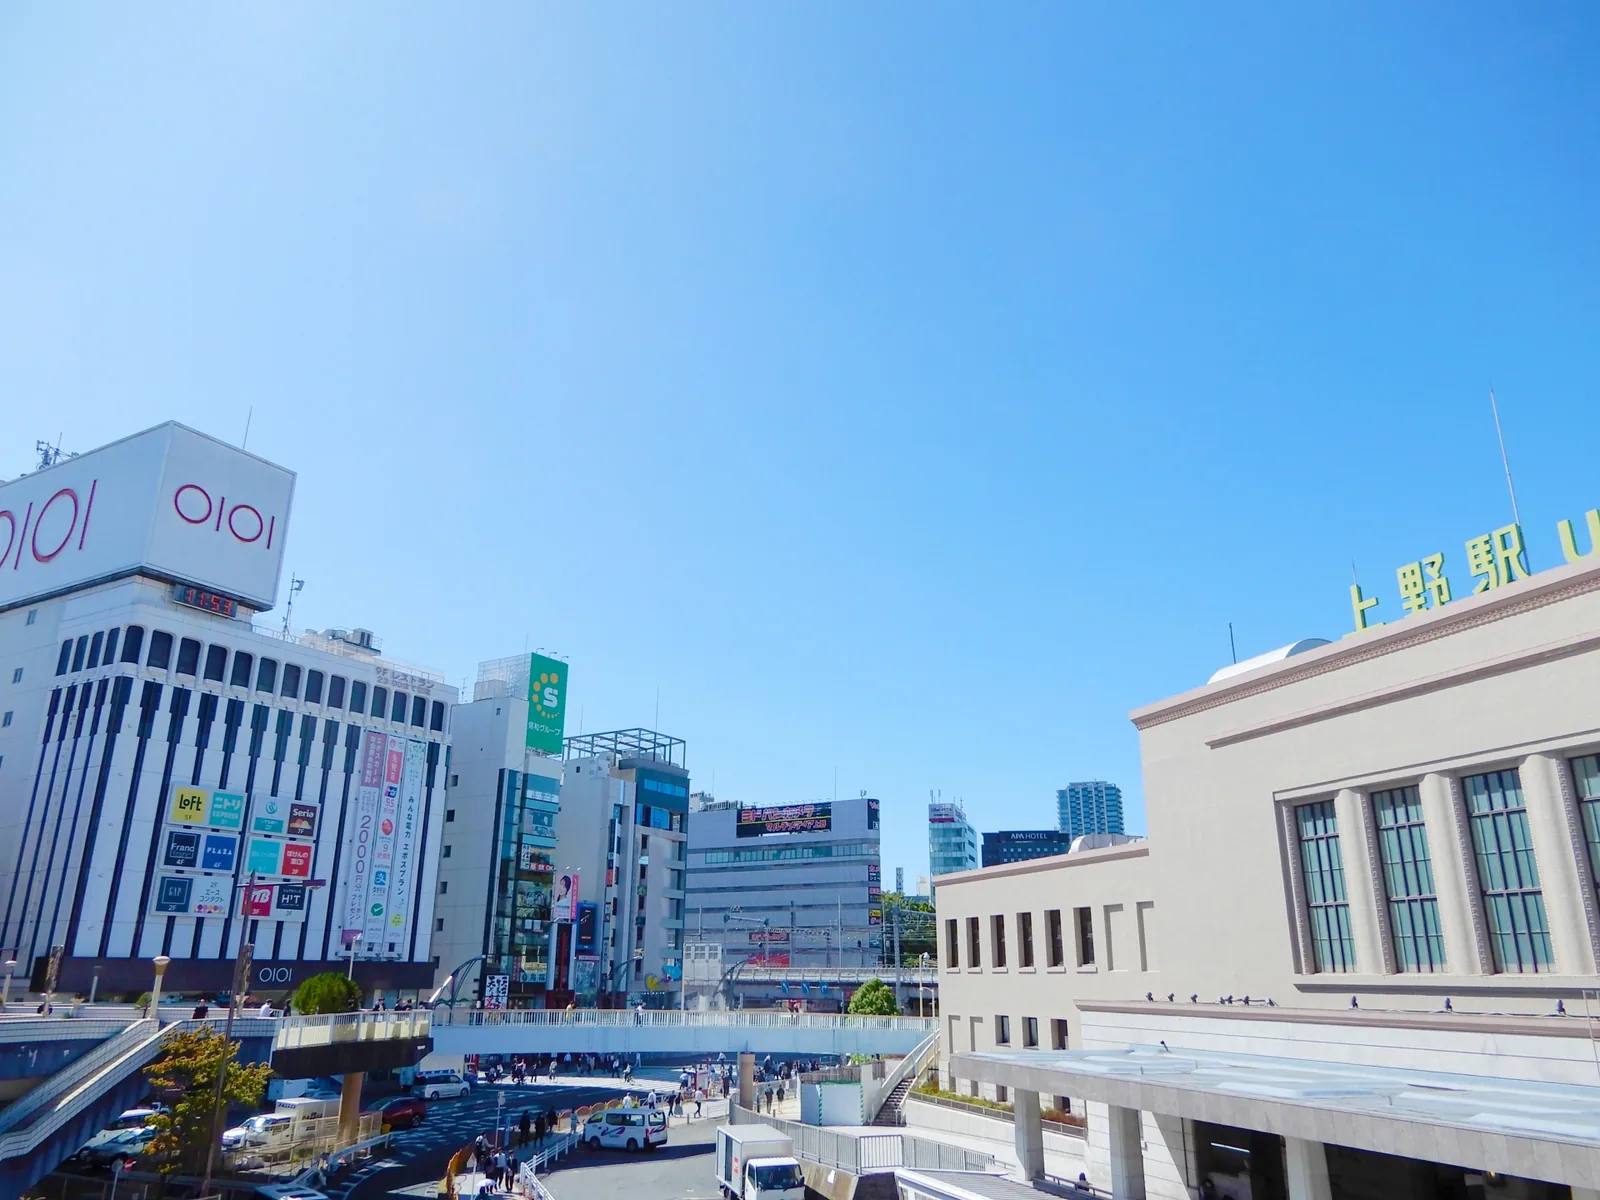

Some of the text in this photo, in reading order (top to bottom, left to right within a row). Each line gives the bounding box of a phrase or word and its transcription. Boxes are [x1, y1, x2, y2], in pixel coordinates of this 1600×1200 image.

[1343, 523, 1531, 638] 上野駅
[186, 586, 233, 616] 11:53
[376, 666, 435, 689] 9F レストラン
[528, 721, 561, 737] 信和グループ
[213, 797, 242, 812] ニトリ
[293, 808, 314, 818] Seria
[741, 805, 815, 823] ヨドバシカメラ
[1025, 832, 1048, 840] HOTEL
[207, 846, 233, 856] PLAZA
[287, 850, 309, 859] ほけんの
[199, 895, 225, 903] コンタクト
